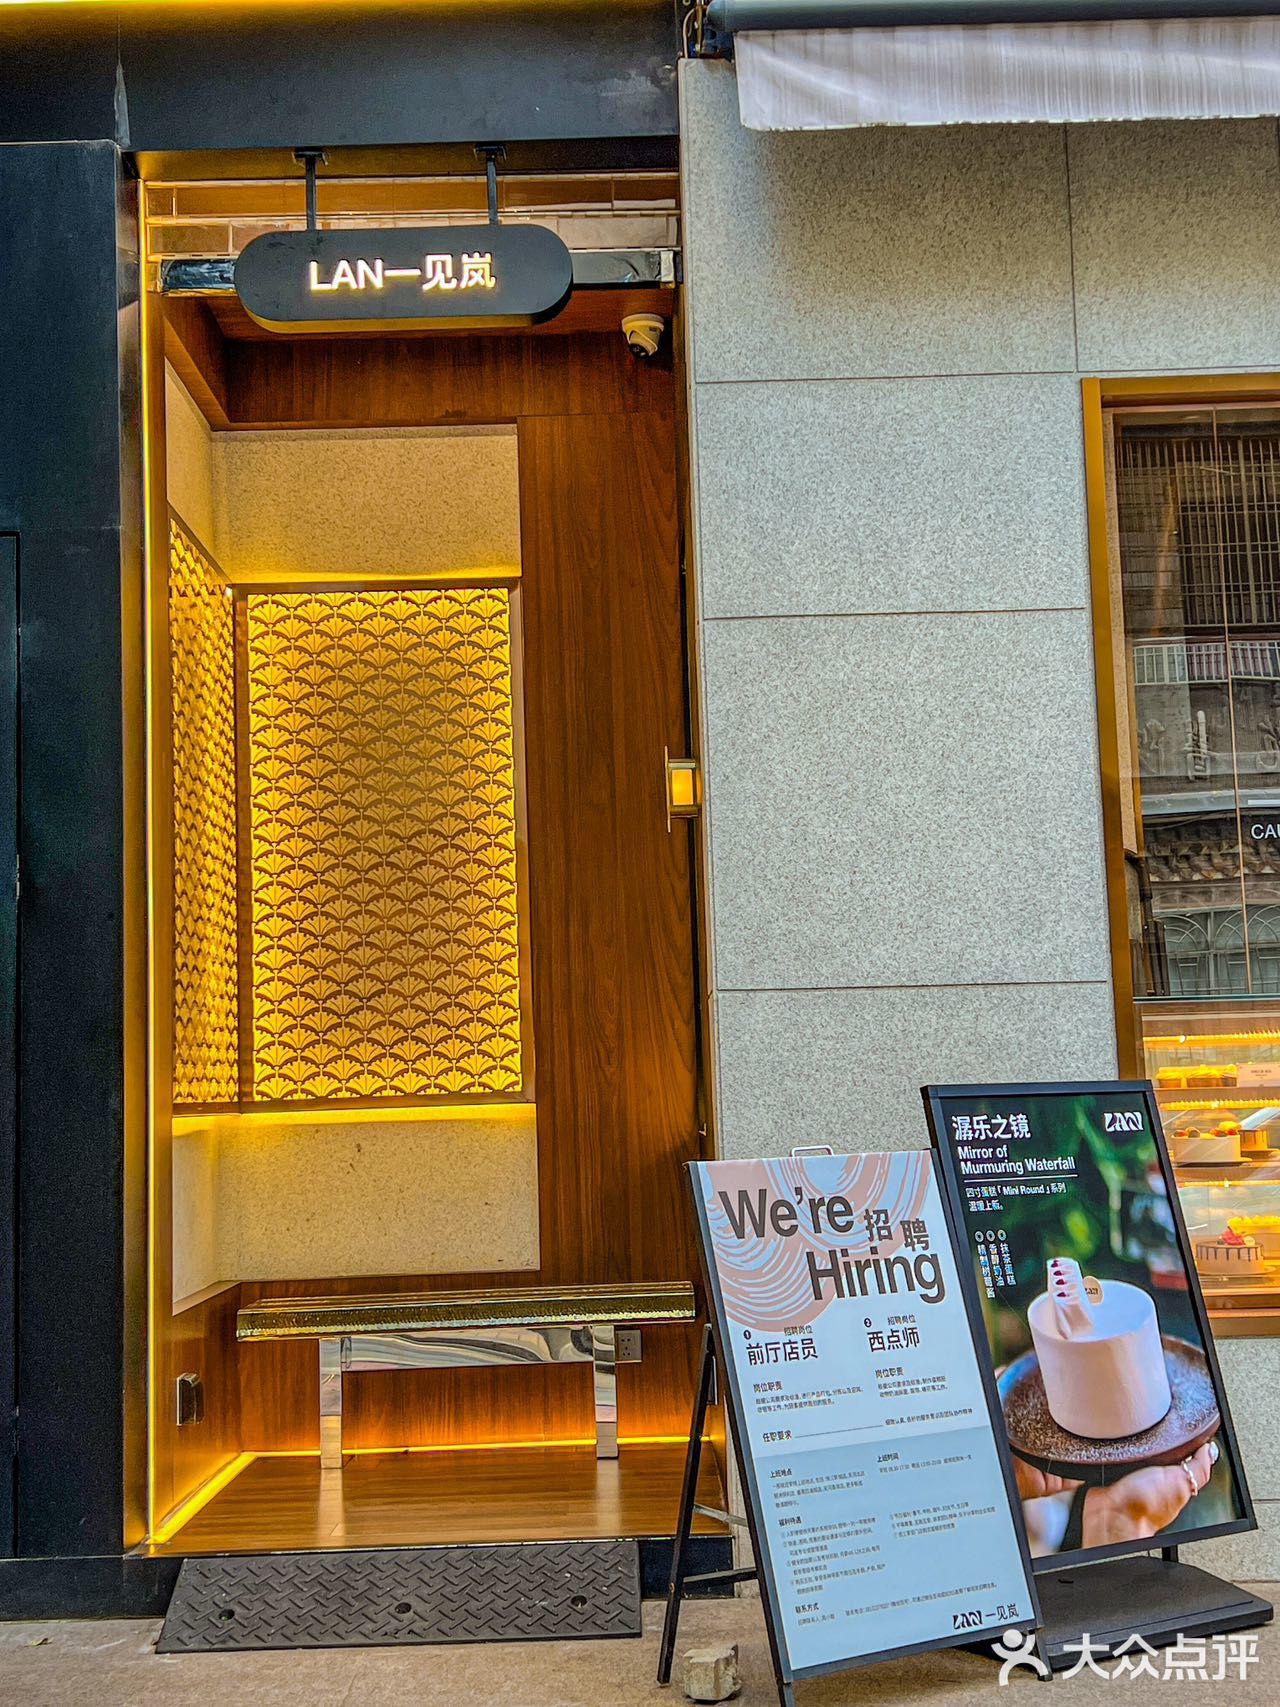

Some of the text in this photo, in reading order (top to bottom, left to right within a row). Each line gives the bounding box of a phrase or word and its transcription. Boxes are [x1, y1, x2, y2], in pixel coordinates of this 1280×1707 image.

[1251, 823, 1280, 839] CA
[952, 1113, 1031, 1141] 潺乐之镜
[1103, 1111, 1144, 1132] LAN
[957, 1145, 1009, 1160] Mirror of
[960, 1157, 1076, 1175] Murmuring Waterfall
[806, 1246, 946, 1304] Hiring
[867, 1326, 920, 1353] 西点师
[746, 1338, 819, 1366] 前厅店员
[762, 1430, 793, 1443] 任职要求
